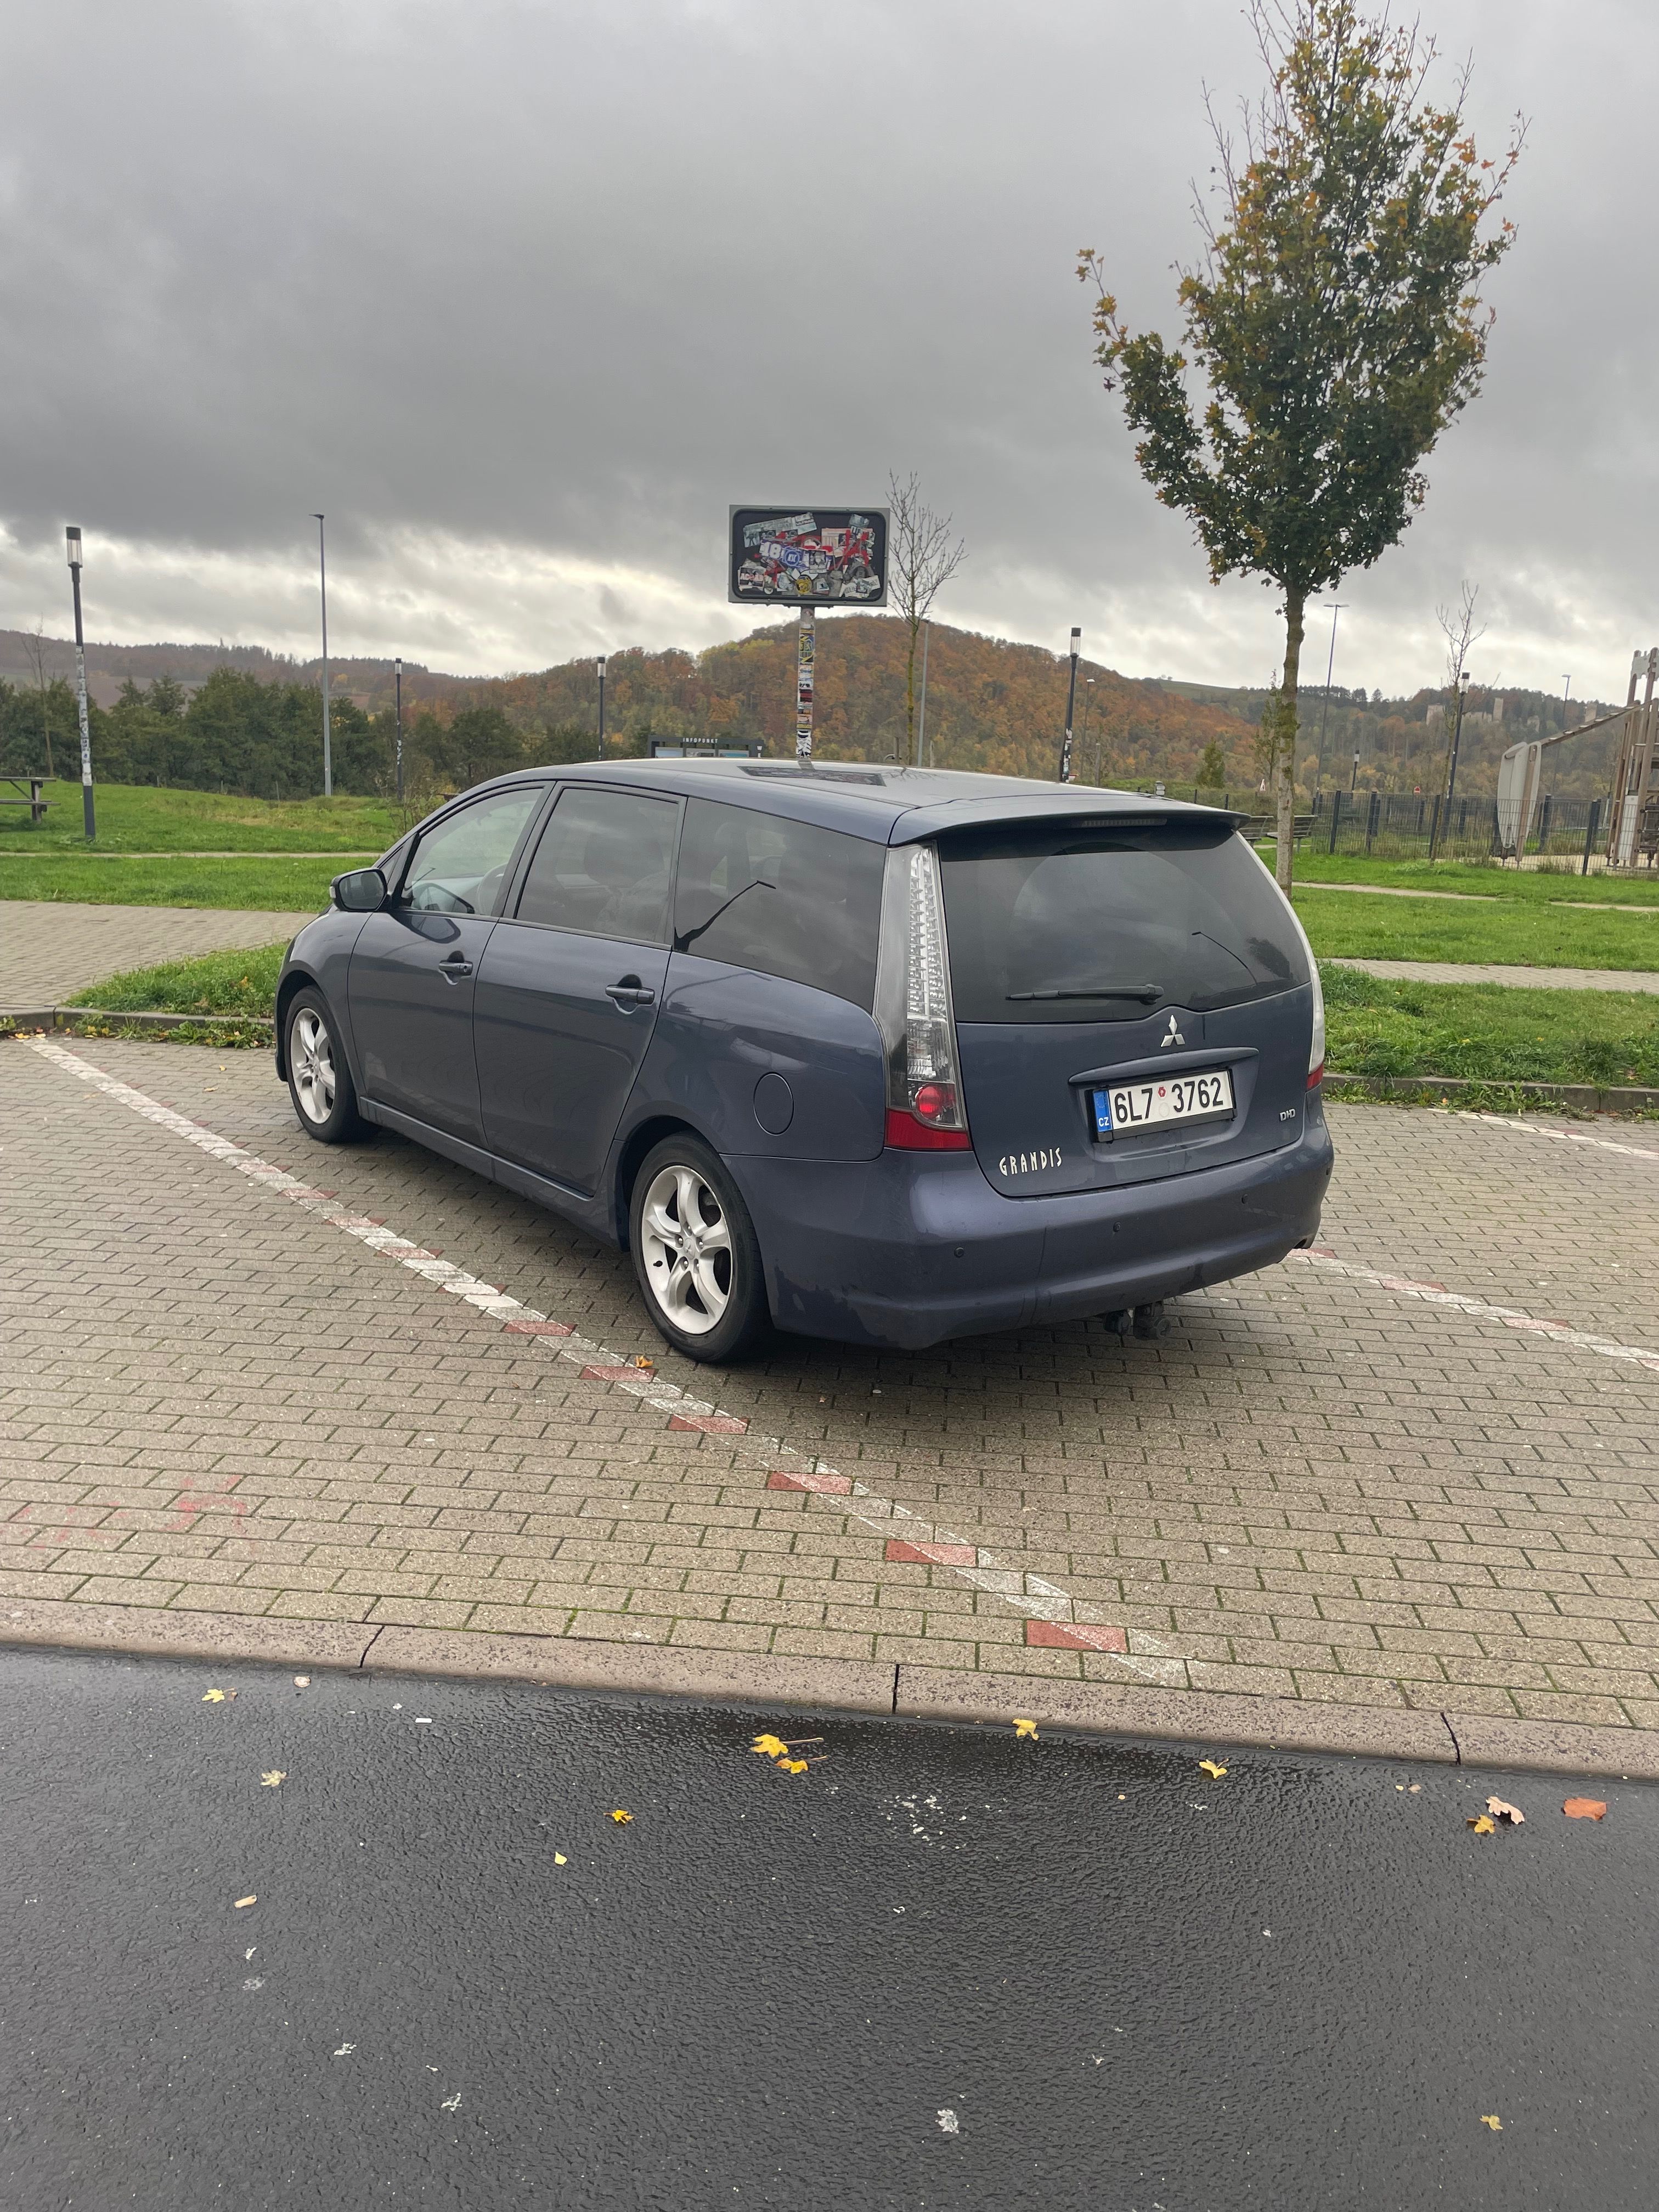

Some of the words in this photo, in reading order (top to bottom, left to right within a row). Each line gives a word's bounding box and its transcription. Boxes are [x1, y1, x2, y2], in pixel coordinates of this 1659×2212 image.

[1114, 1088, 1153, 1122] 6L7
[1171, 1077, 1223, 1113] 3762
[1098, 1116, 1109, 1127] CZ
[999, 1147, 1062, 1176] GRANDIS
